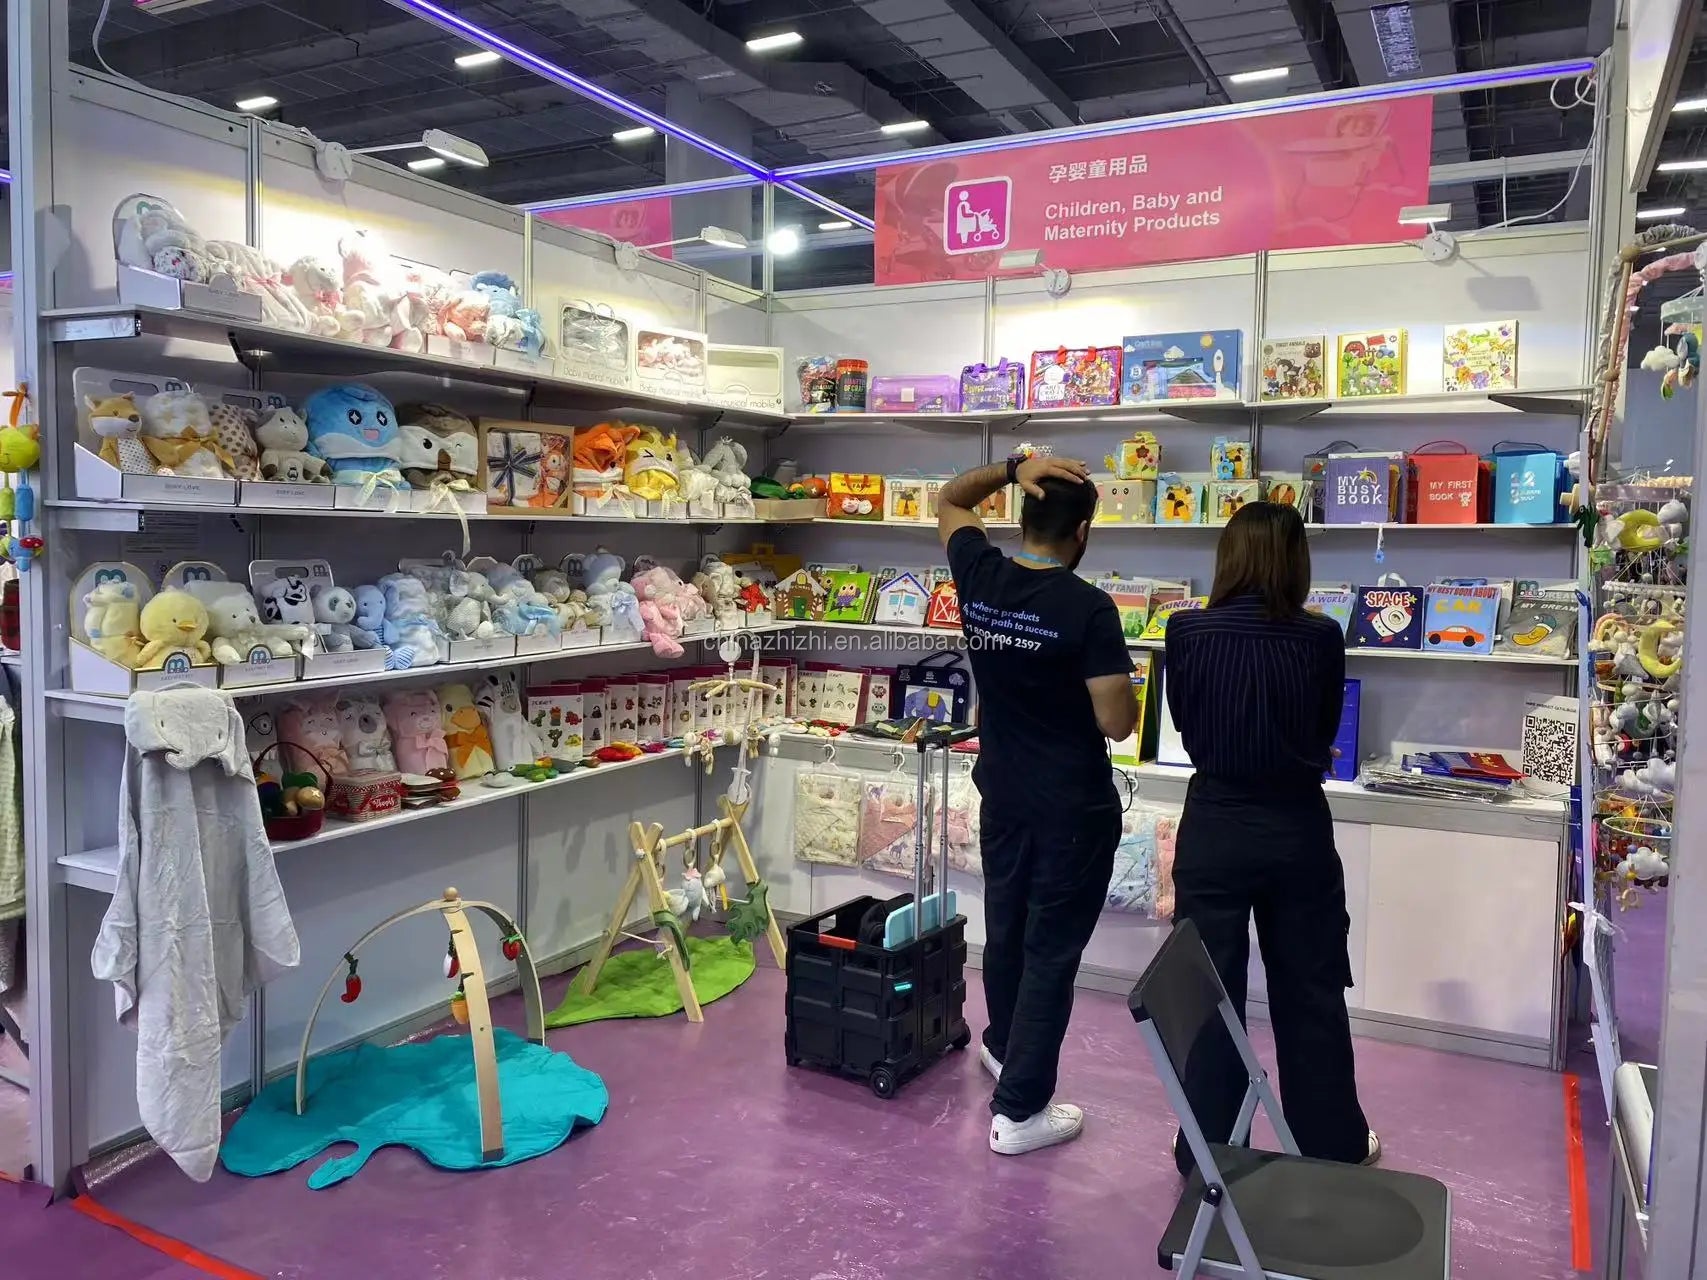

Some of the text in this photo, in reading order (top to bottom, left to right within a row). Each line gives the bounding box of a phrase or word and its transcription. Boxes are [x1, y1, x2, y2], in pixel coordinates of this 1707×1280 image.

[1048, 154, 1149, 184] 孕婴童用品
[1045, 185, 1223, 220] Children, Baby and
[1044, 210, 1221, 241] Maternity Products
[639, 383, 657, 396] Baby
[749, 399, 776, 410] mobile
[1337, 475, 1358, 486] MY
[1429, 479, 1473, 490] MY FIRST
[1337, 484, 1381, 495] BUSY
[1337, 493, 1383, 505] BOOK
[1429, 493, 1454, 501] BOOK
[1101, 582, 1147, 594] MY FAMILY
[1438, 586, 1455, 595] BEST
[1455, 587, 1473, 597] BOOK
[1473, 586, 1498, 600] ABOUT
[1318, 595, 1349, 604] WORLD
[1367, 591, 1410, 607] SPACE
[972, 601, 1000, 615] where
[1001, 610, 1041, 623] products
[1159, 600, 1203, 612] JUNGLE
[1434, 599, 1482, 614] CAR
[1540, 603, 1579, 613] DREAM
[969, 610, 1059, 639] their path to success
[993, 633, 1013, 645] 606
[1014, 637, 1042, 651] 2597
